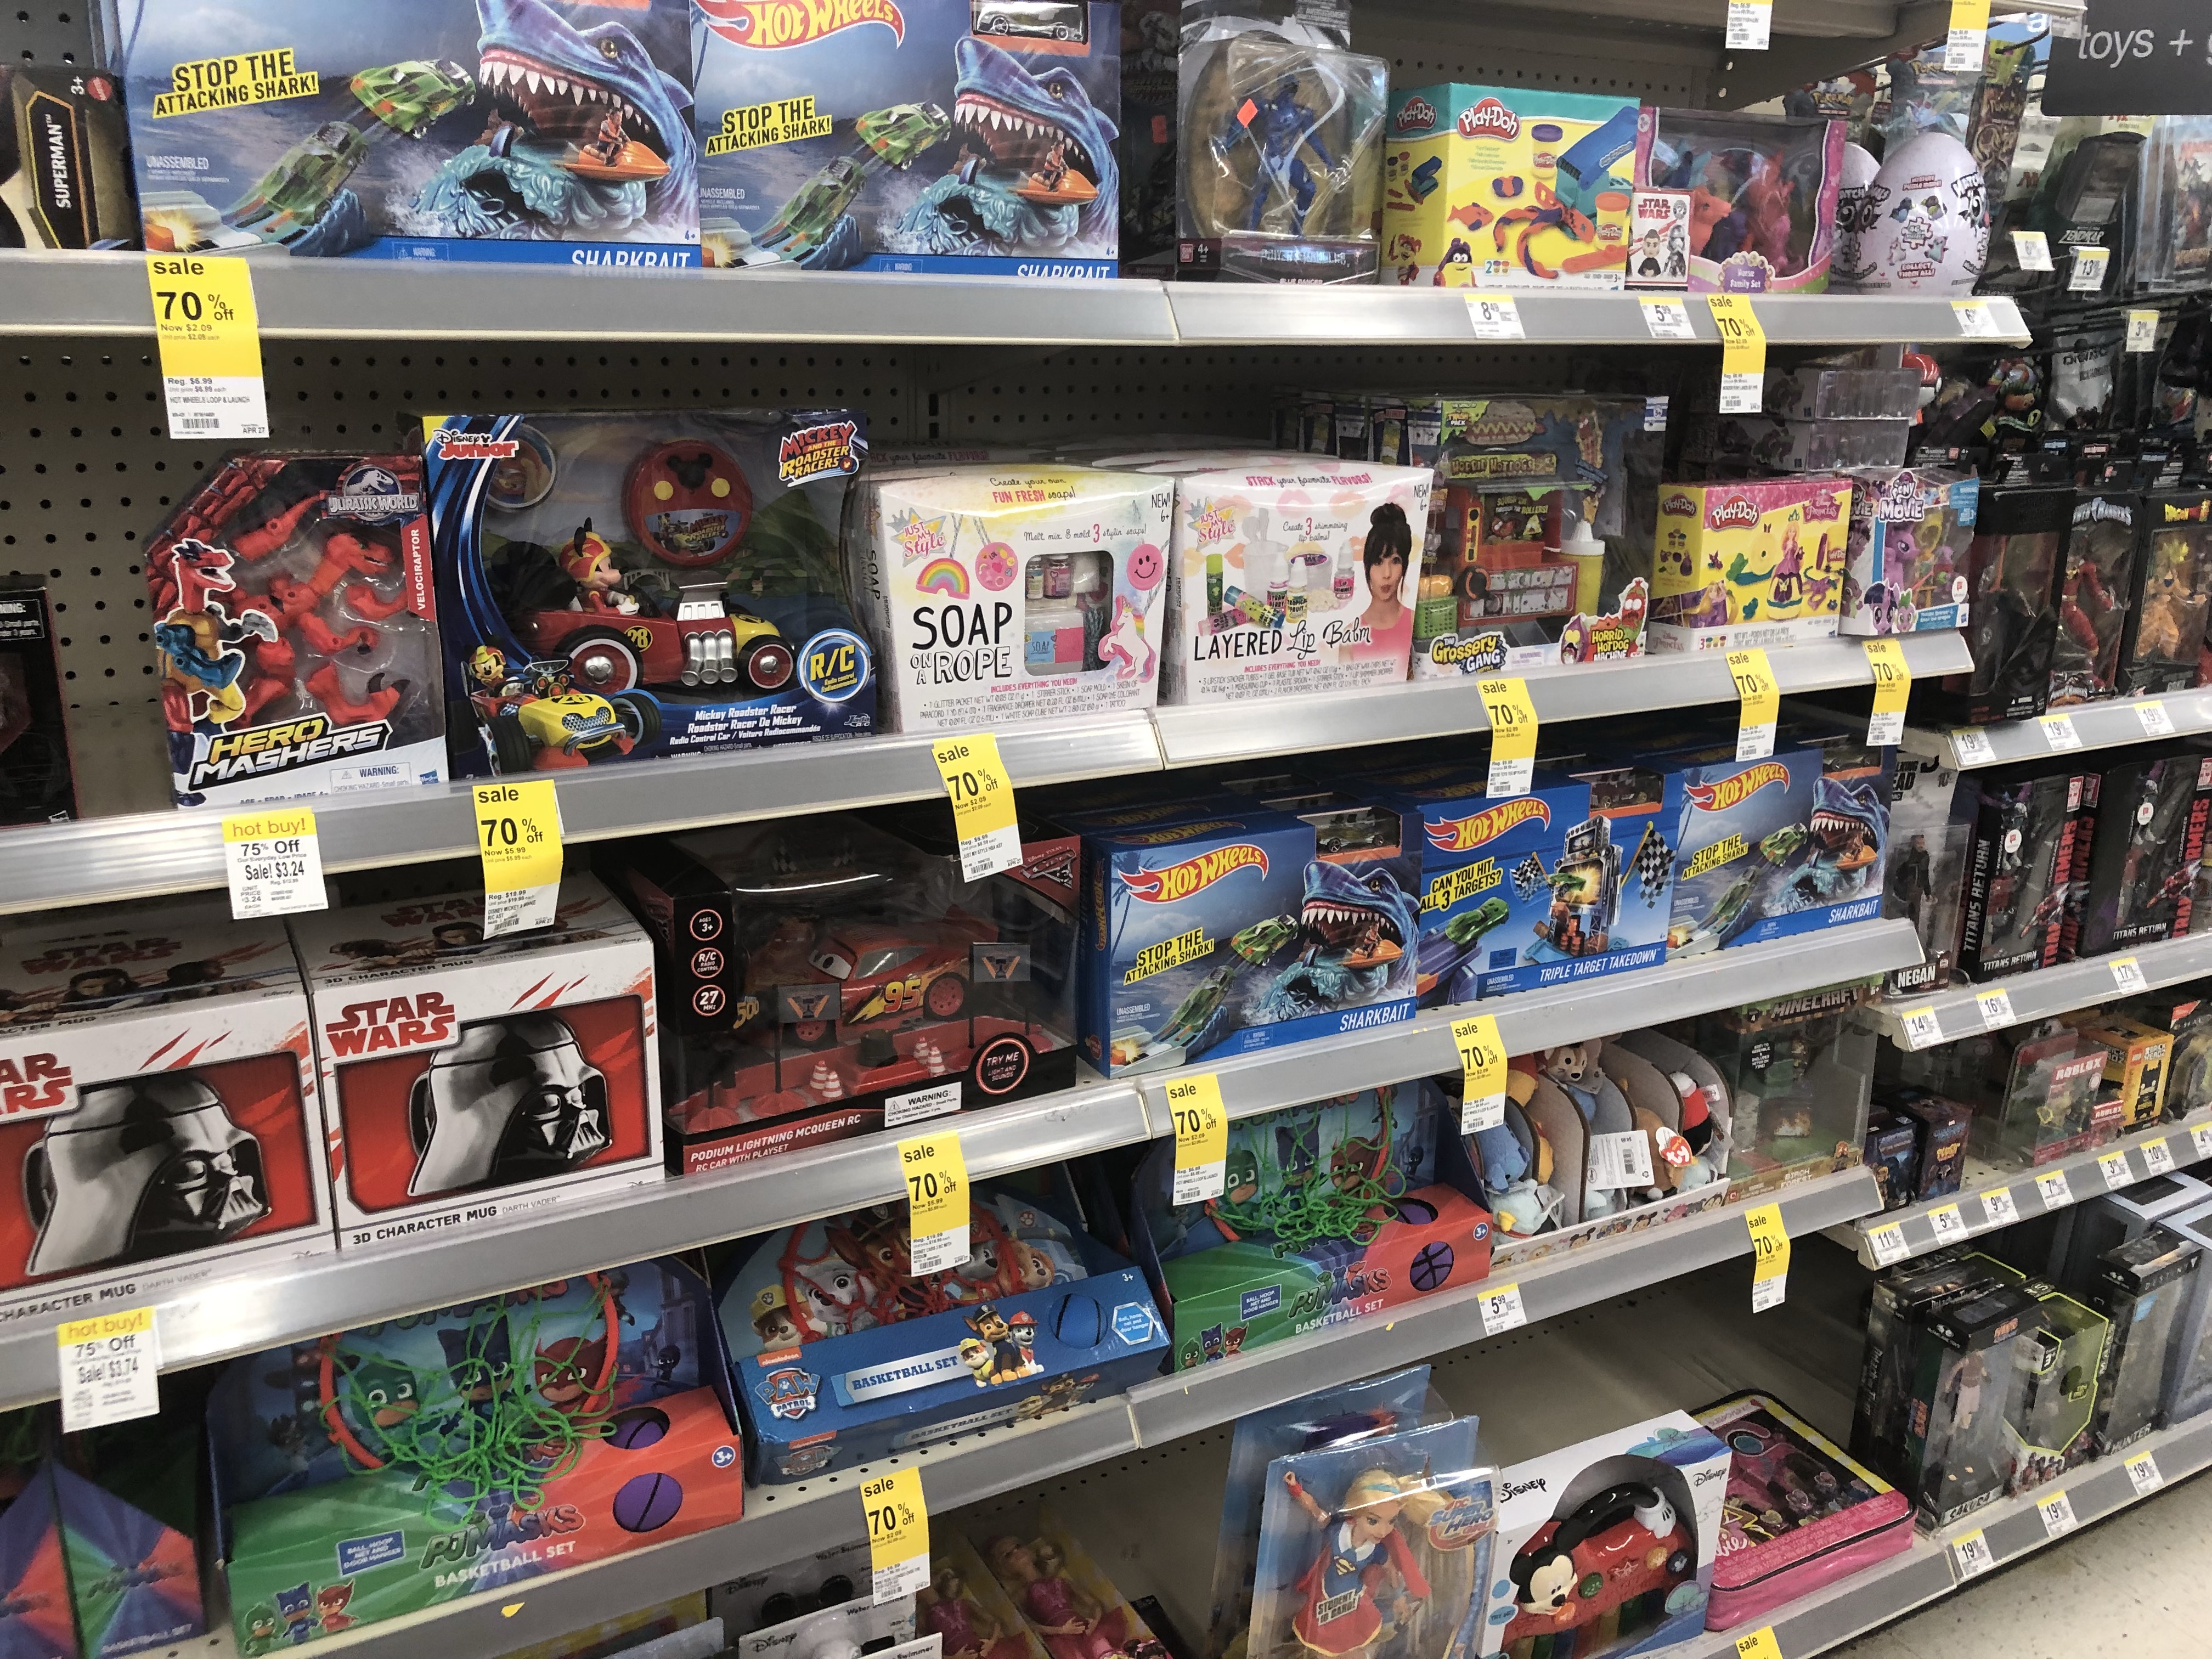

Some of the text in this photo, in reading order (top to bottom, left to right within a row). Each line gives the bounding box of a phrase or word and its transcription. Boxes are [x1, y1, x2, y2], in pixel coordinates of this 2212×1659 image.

[2078, 28, 2154, 69] toys
[174, 52, 294, 92] STOP THE
[155, 78, 317, 115] ATTACKING SHARK!
[724, 98, 812, 133] STOP THE
[707, 117, 831, 154] ATTACKING SHARK!
[146, 155, 208, 170] UNASSEMBLED
[1638, 199, 1669, 210] STAR
[1639, 208, 1669, 220] WARS
[154, 258, 204, 275] sale
[156, 291, 234, 321] 70 off
[1711, 297, 1733, 308] sale
[161, 324, 212, 332] Now $2.09
[1718, 318, 1742, 337] 70
[796, 458, 839, 477] RACERS
[990, 477, 1021, 488] Create
[1246, 474, 1373, 487] STACK favorite FLAVORS!
[330, 495, 417, 512] JURASSIC WORLD
[994, 487, 1075, 503] FUN FRESH soaps!
[1152, 494, 1171, 508] NEW!
[1879, 499, 1924, 521] MOVIE
[904, 521, 924, 538] JUST
[1024, 531, 1045, 541] Melt
[1283, 521, 1305, 533] Create
[904, 534, 945, 557] Style
[409, 529, 426, 610] VELOCIRAPTOR
[912, 602, 1012, 650] SOAP
[1592, 629, 1623, 642] HORRID
[628, 628, 648, 648] 28
[1031, 640, 1050, 653] SOAP
[1194, 619, 1372, 661] LAYERED Lip Balm
[1597, 640, 1613, 651] HOT
[1433, 635, 1497, 664] Grossery
[1867, 644, 1886, 653] sale
[810, 646, 854, 681] R/C
[911, 653, 932, 669] ON
[933, 646, 1012, 684] ROPE
[1466, 650, 1501, 673] GANG
[1873, 663, 1893, 681] 70
[991, 684, 1016, 693] INCLUDES
[1018, 681, 1049, 691] EVERYTHING
[1483, 682, 1506, 694] sale
[695, 704, 797, 721] Mickey Roadster Racer
[1488, 705, 1513, 725] 70
[687, 715, 803, 733] Roadster Racer De Mickey
[210, 718, 325, 762] HERO
[669, 730, 763, 745] Radio Control Car Voiture
[193, 726, 385, 786] MASHERS
[938, 745, 969, 763] sale
[359, 765, 399, 778] WARNING:
[478, 787, 519, 804] sale
[947, 772, 998, 801] 70 off
[970, 797, 986, 805] $2.09
[233, 819, 306, 838] hot buy!
[481, 818, 543, 847] 70 off
[274, 839, 300, 854] Off
[505, 847, 526, 855] $5.99
[245, 860, 305, 881] Sale! $3.24
[1431, 864, 1492, 894] CAN YOU HIT
[505, 890, 526, 898] $19.99
[1420, 873, 1502, 912] ALL 3 TARGETS?
[1828, 900, 1878, 923] SHARKBAIT
[698, 952, 716, 961] R/C
[1137, 929, 1202, 967] STOP THE
[1179, 941, 1214, 964] SHARK!
[1539, 964, 1570, 982] TRIPLE
[1573, 957, 1606, 977] TARGET
[1983, 951, 2037, 971] TITANS RETURN
[1897, 966, 1936, 988] NEGAN
[700, 991, 718, 1005] 27
[884, 979, 921, 1013] 95
[326, 991, 455, 1031] STAR
[1339, 1005, 1409, 1031] SHARKBAIT
[326, 1018, 456, 1057] WARS
[1455, 1023, 1479, 1037] sale
[987, 1052, 1019, 1066] TRY ME
[908, 1090, 951, 1106] WARNING:
[1170, 1084, 1197, 1099] sale
[1175, 1109, 1217, 1135] 70 off
[691, 1114, 861, 1163] PODIUM LIGHTNING MCQUEEN RC
[904, 1144, 935, 1164] sale
[909, 1173, 938, 1201] 70
[502, 1202, 528, 1214] DARTH
[376, 1206, 497, 1242] CHARACTER MUG
[1754, 1236, 1773, 1256] 70
[1296, 1299, 1384, 1334] BASKETBALL SET
[852, 1356, 958, 1390] BASKETBALL SET
[776, 1399, 811, 1411] PATROL
[864, 1478, 894, 1498] sale
[868, 1506, 896, 1535] 70
[435, 1541, 576, 1589] BASKETBALL SET
